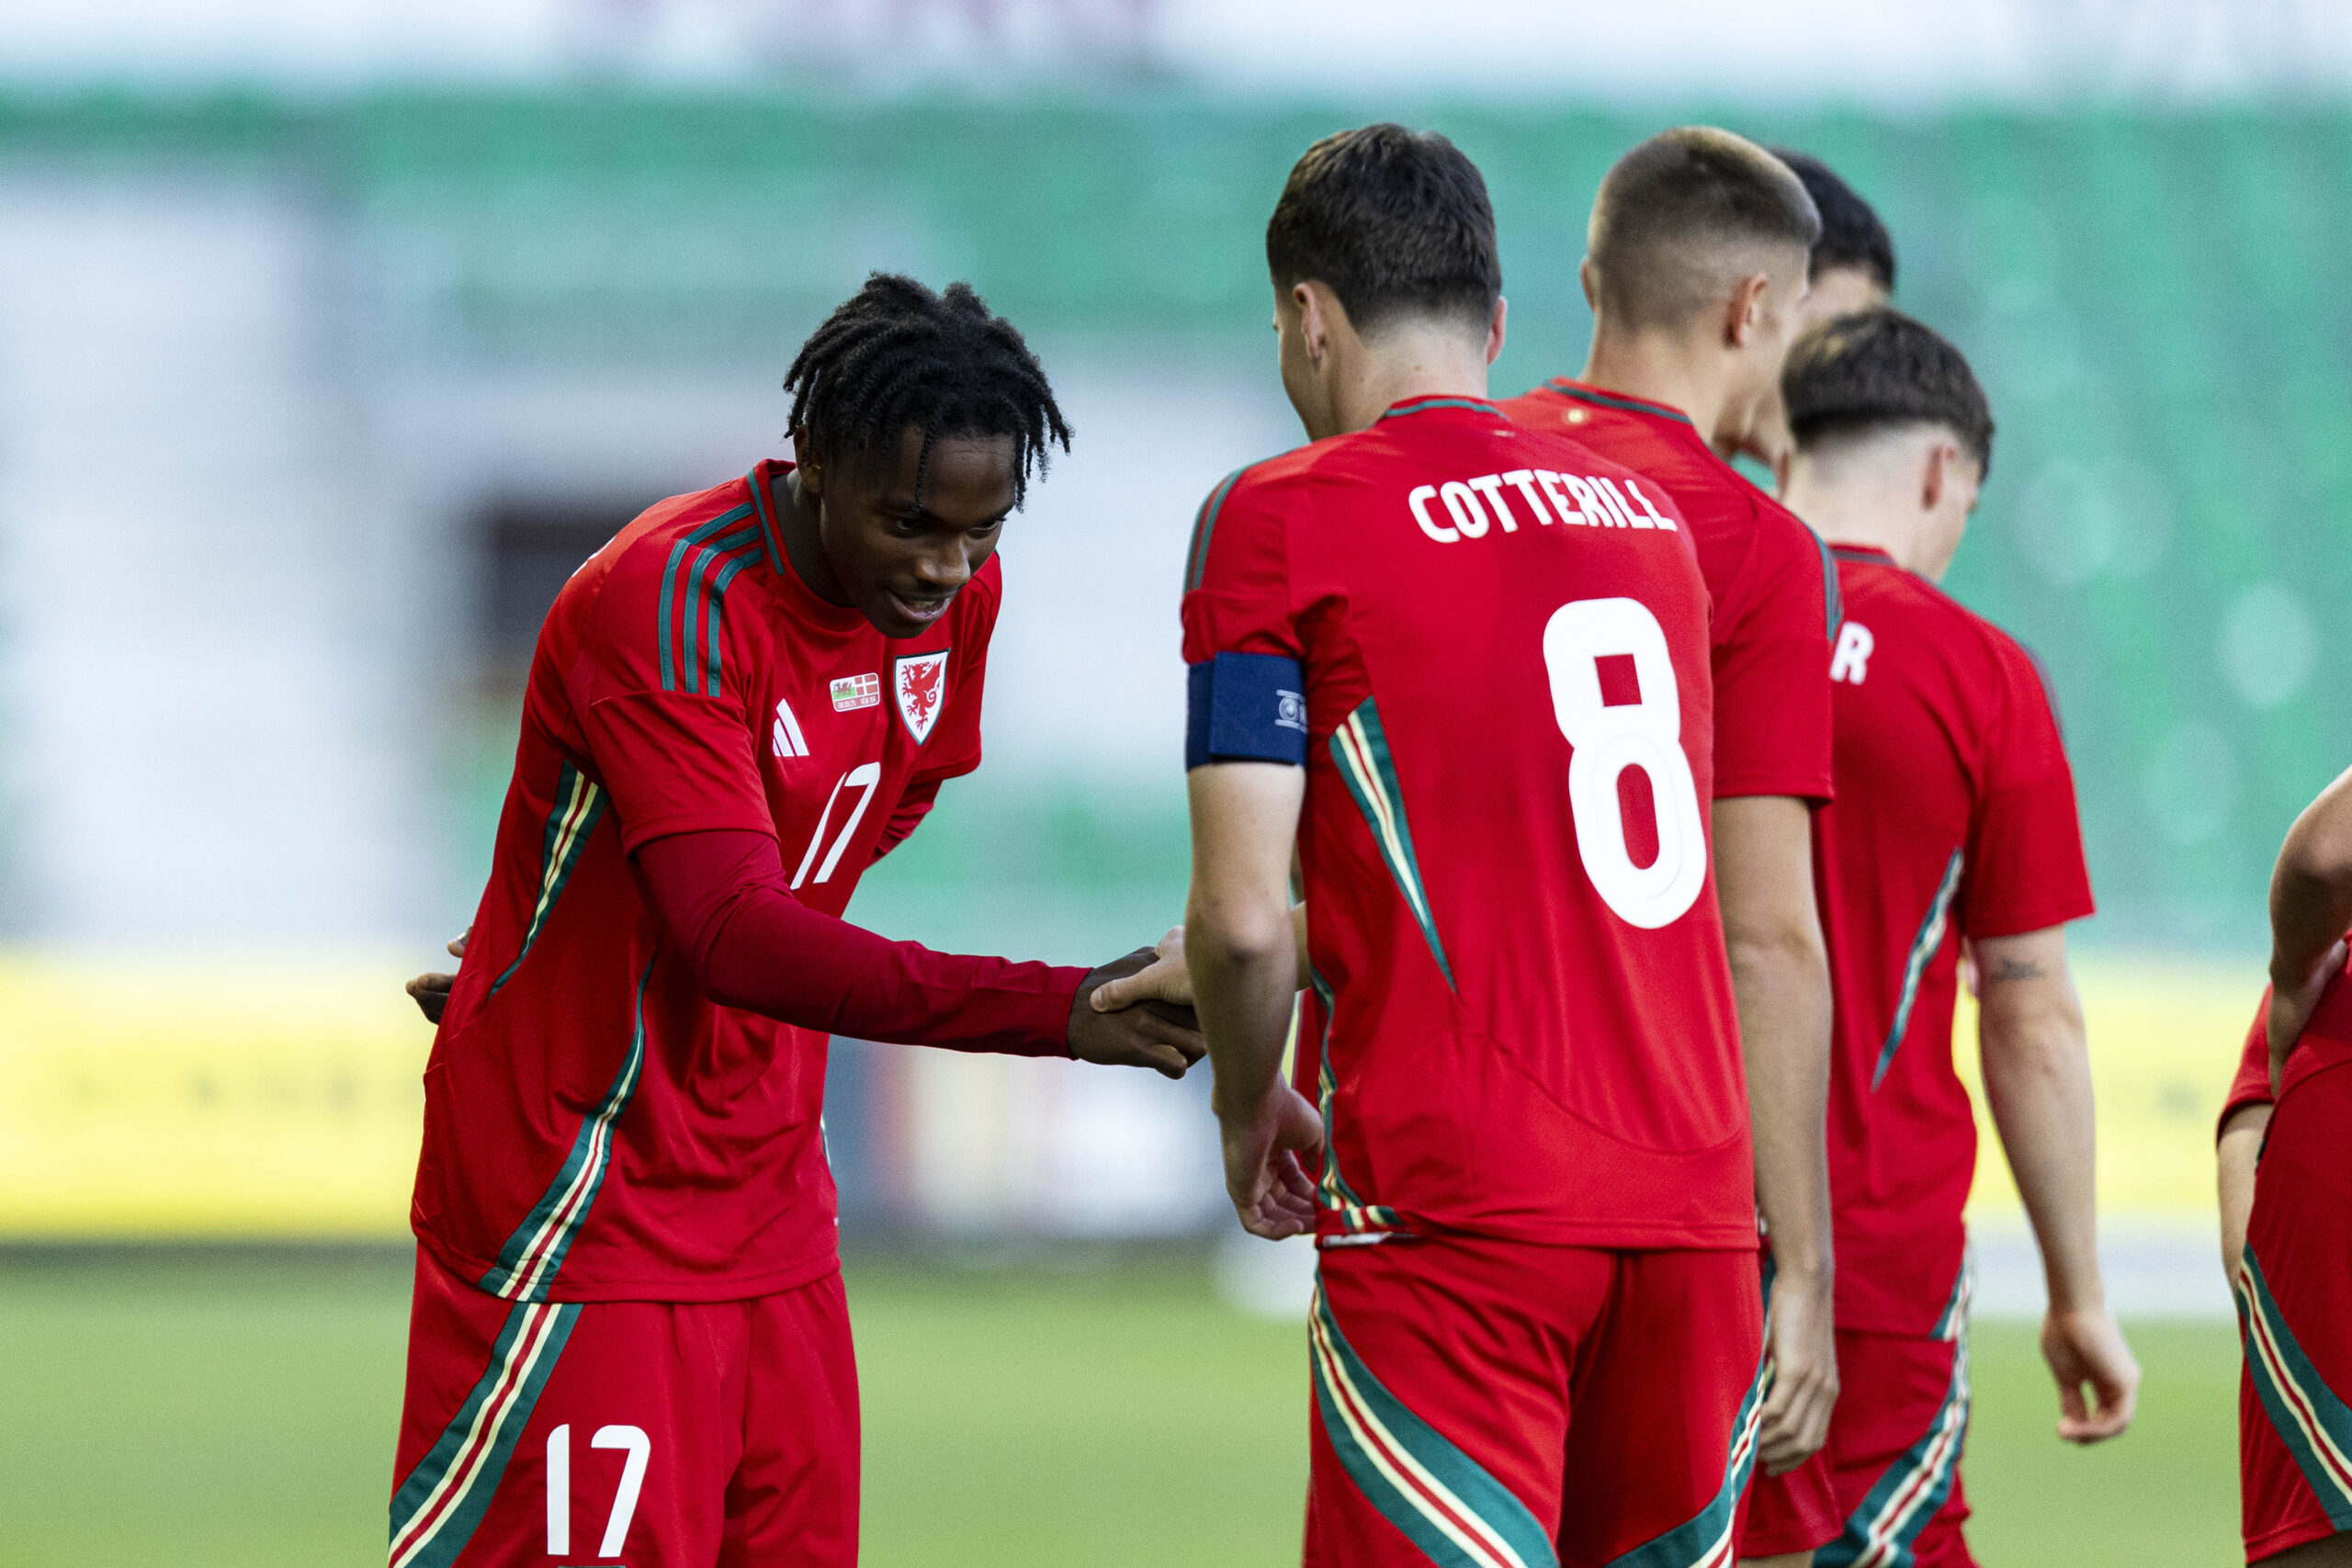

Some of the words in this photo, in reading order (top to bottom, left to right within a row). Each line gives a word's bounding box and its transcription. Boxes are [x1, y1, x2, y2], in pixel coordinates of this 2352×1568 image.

[1408, 468, 1678, 543] COTTERILL
[790, 761, 881, 890] 17
[1543, 597, 1707, 930] 8
[547, 1424, 651, 1559] 17
